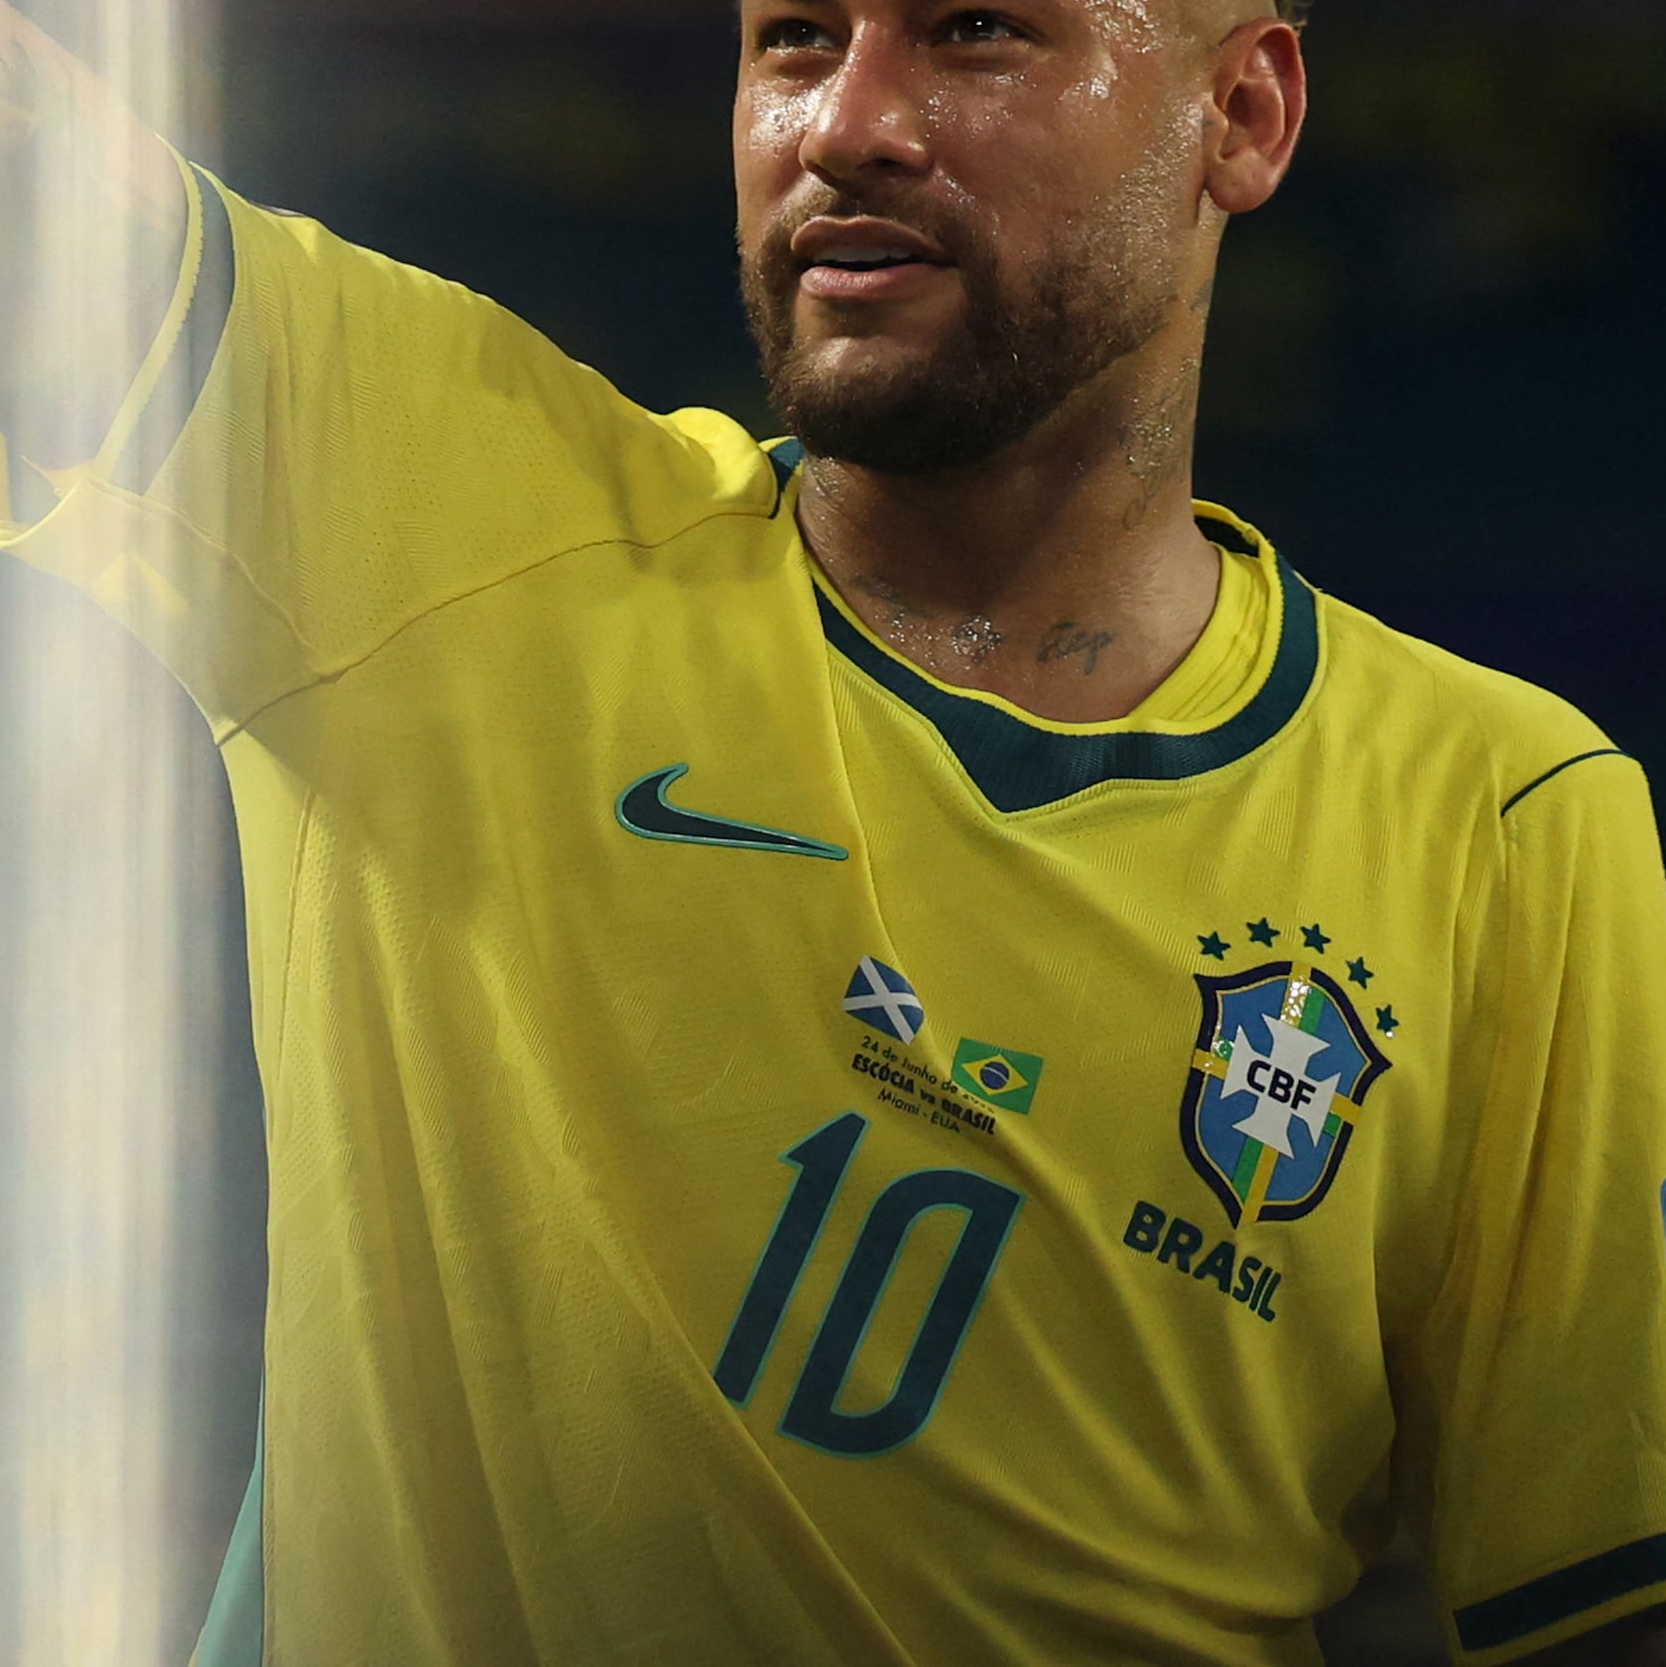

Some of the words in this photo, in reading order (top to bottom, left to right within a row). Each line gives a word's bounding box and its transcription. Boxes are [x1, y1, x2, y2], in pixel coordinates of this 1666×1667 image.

[861, 1035, 879, 1053] 24
[883, 1047, 898, 1062] de
[852, 1053, 914, 1094] ESCÓCIA
[941, 1098, 996, 1135] BRASIL
[877, 1088, 919, 1115] Miami
[930, 1111, 961, 1134] EUA
[1246, 1060, 1315, 1111] CBF
[713, 1109, 1026, 1460] 10
[1123, 1200, 1282, 1323] BRASIL
